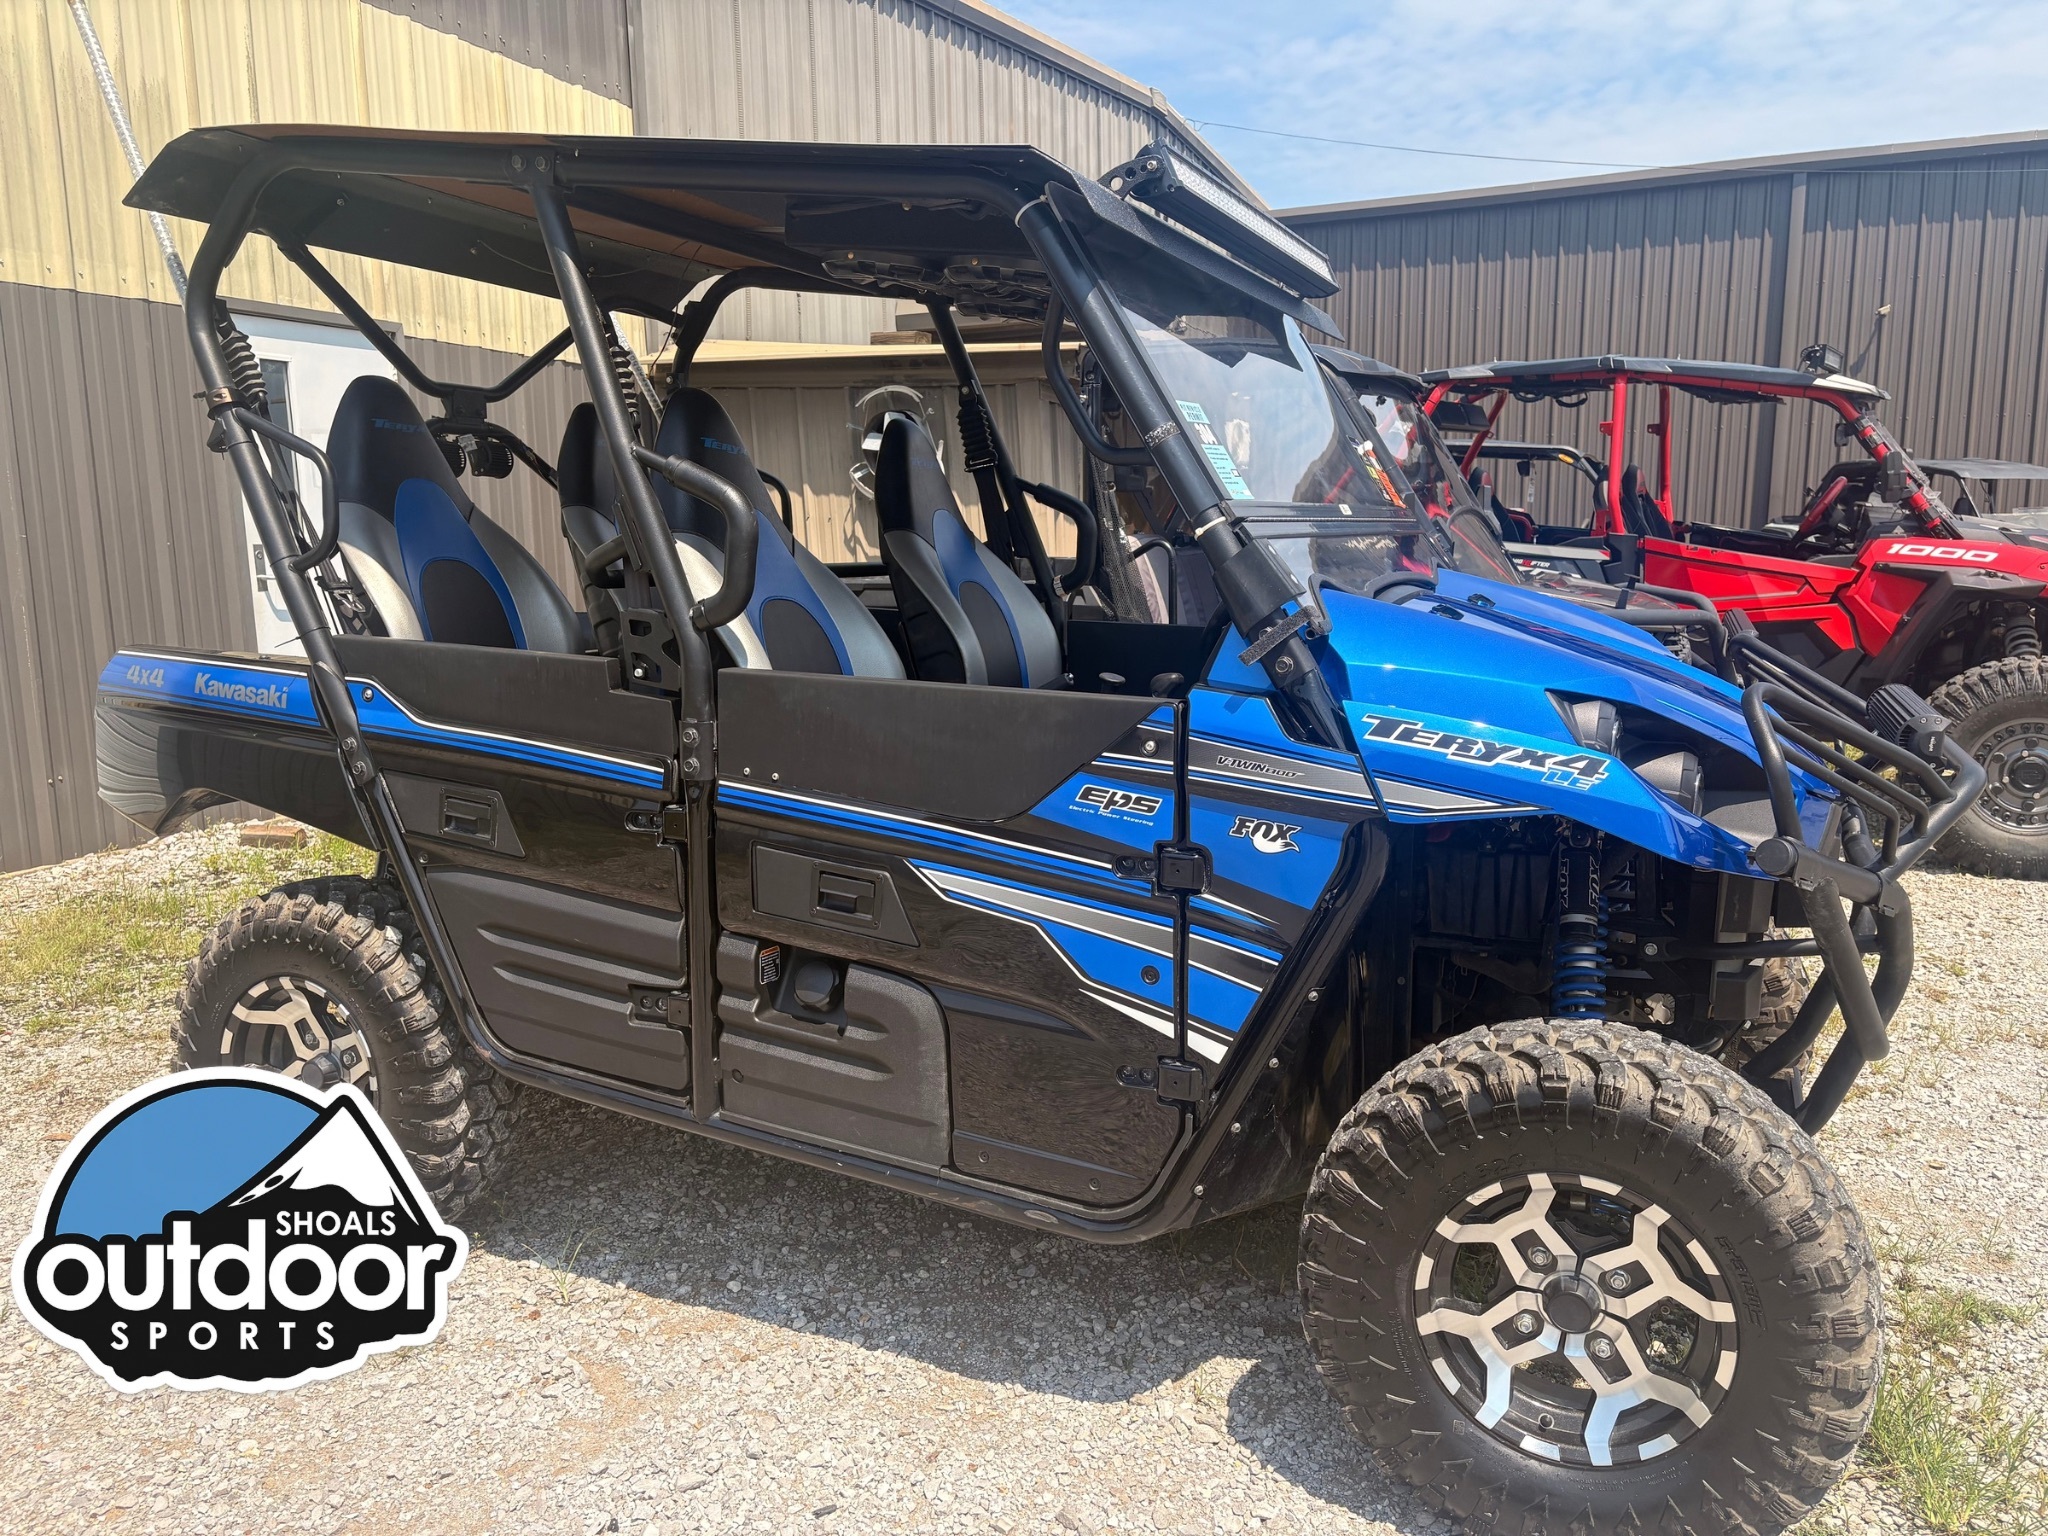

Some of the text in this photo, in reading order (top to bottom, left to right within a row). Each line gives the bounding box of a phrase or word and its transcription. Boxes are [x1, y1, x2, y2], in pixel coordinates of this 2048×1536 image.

[1886, 542, 1999, 563] 1000
[126, 664, 164, 688] 4x4
[194, 672, 289, 709] Kawasaki
[1541, 769, 1602, 790] LE
[1075, 784, 1163, 816] EPS
[1068, 804, 1154, 827] Electric Power Steering
[1229, 815, 1302, 845] FOX
